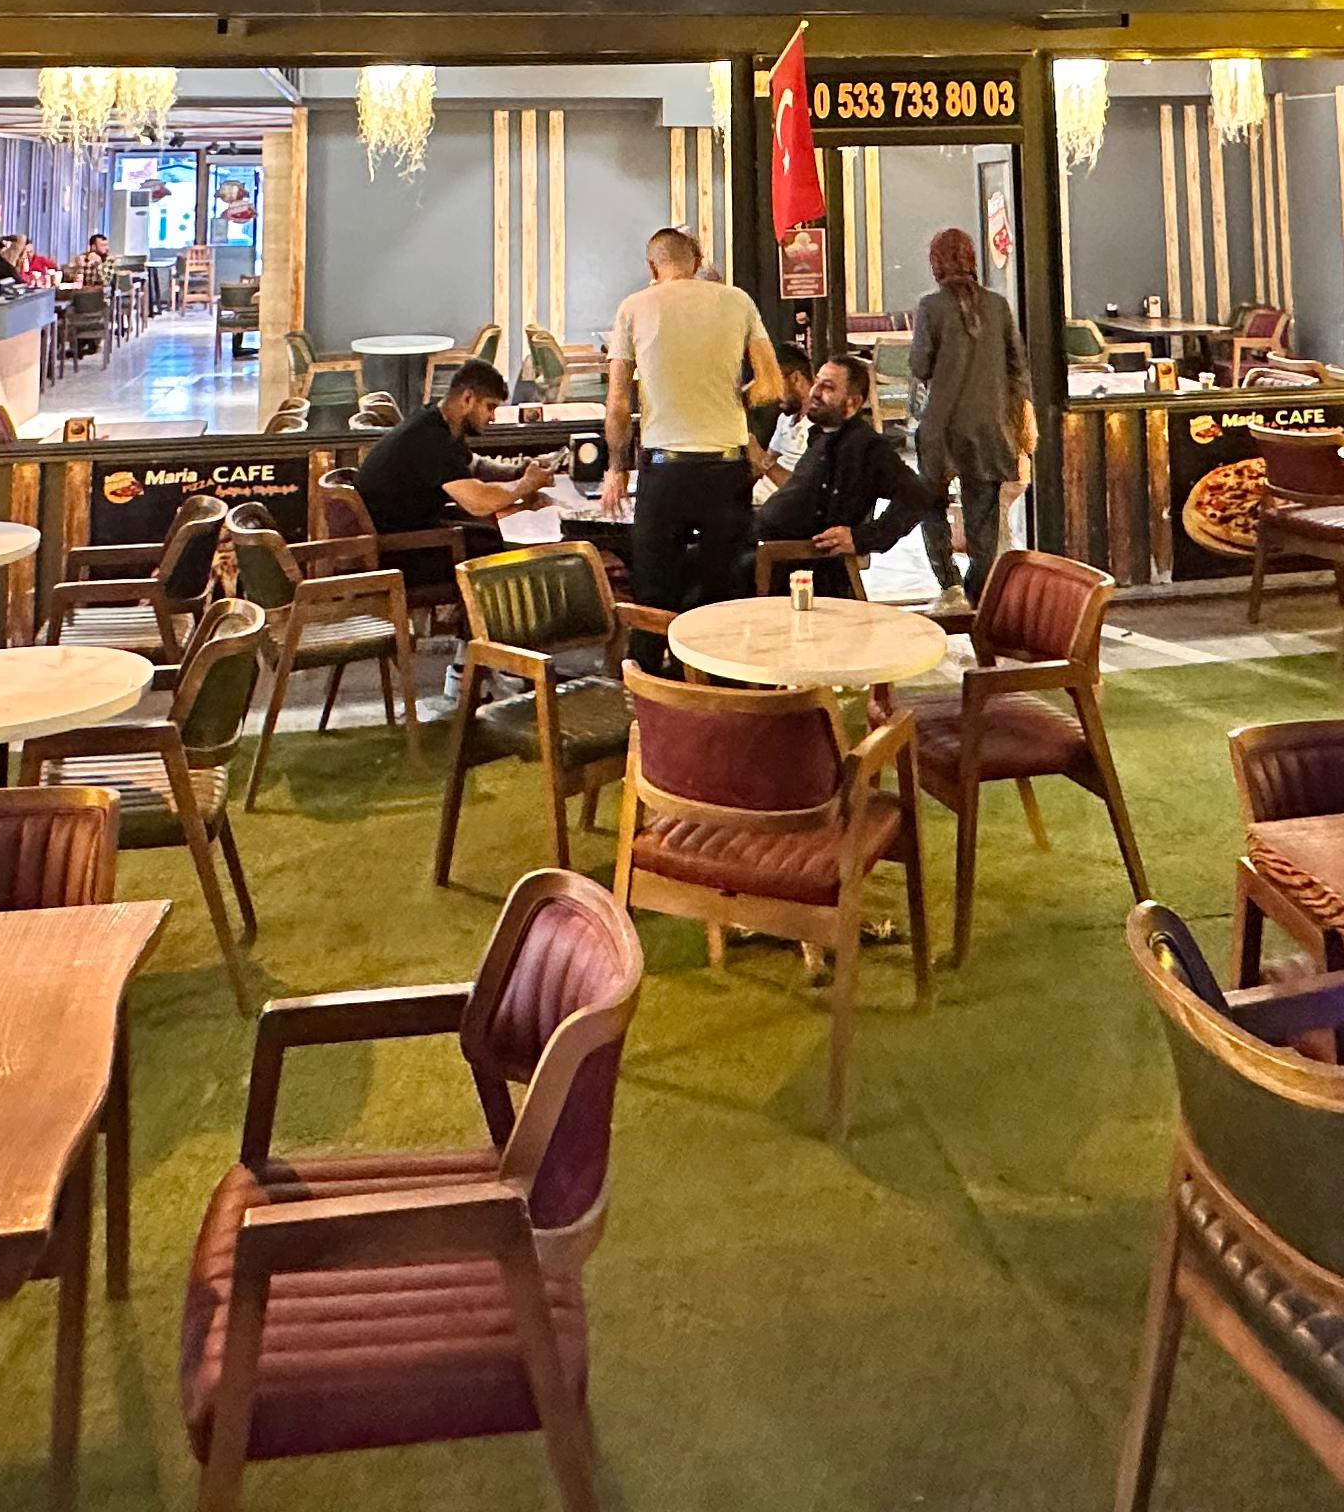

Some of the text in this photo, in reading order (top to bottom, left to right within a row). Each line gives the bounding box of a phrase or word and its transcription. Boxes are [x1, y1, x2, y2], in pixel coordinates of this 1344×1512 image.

[837, 82, 885, 119] 533
[891, 81, 939, 119] 733
[945, 80, 977, 117] 80
[983, 80, 1015, 117] 03
[1222, 412, 1264, 428] Maria
[1275, 408, 1325, 424] CAFE
[145, 468, 198, 486] Maria
[212, 465, 276, 483] CAFE
